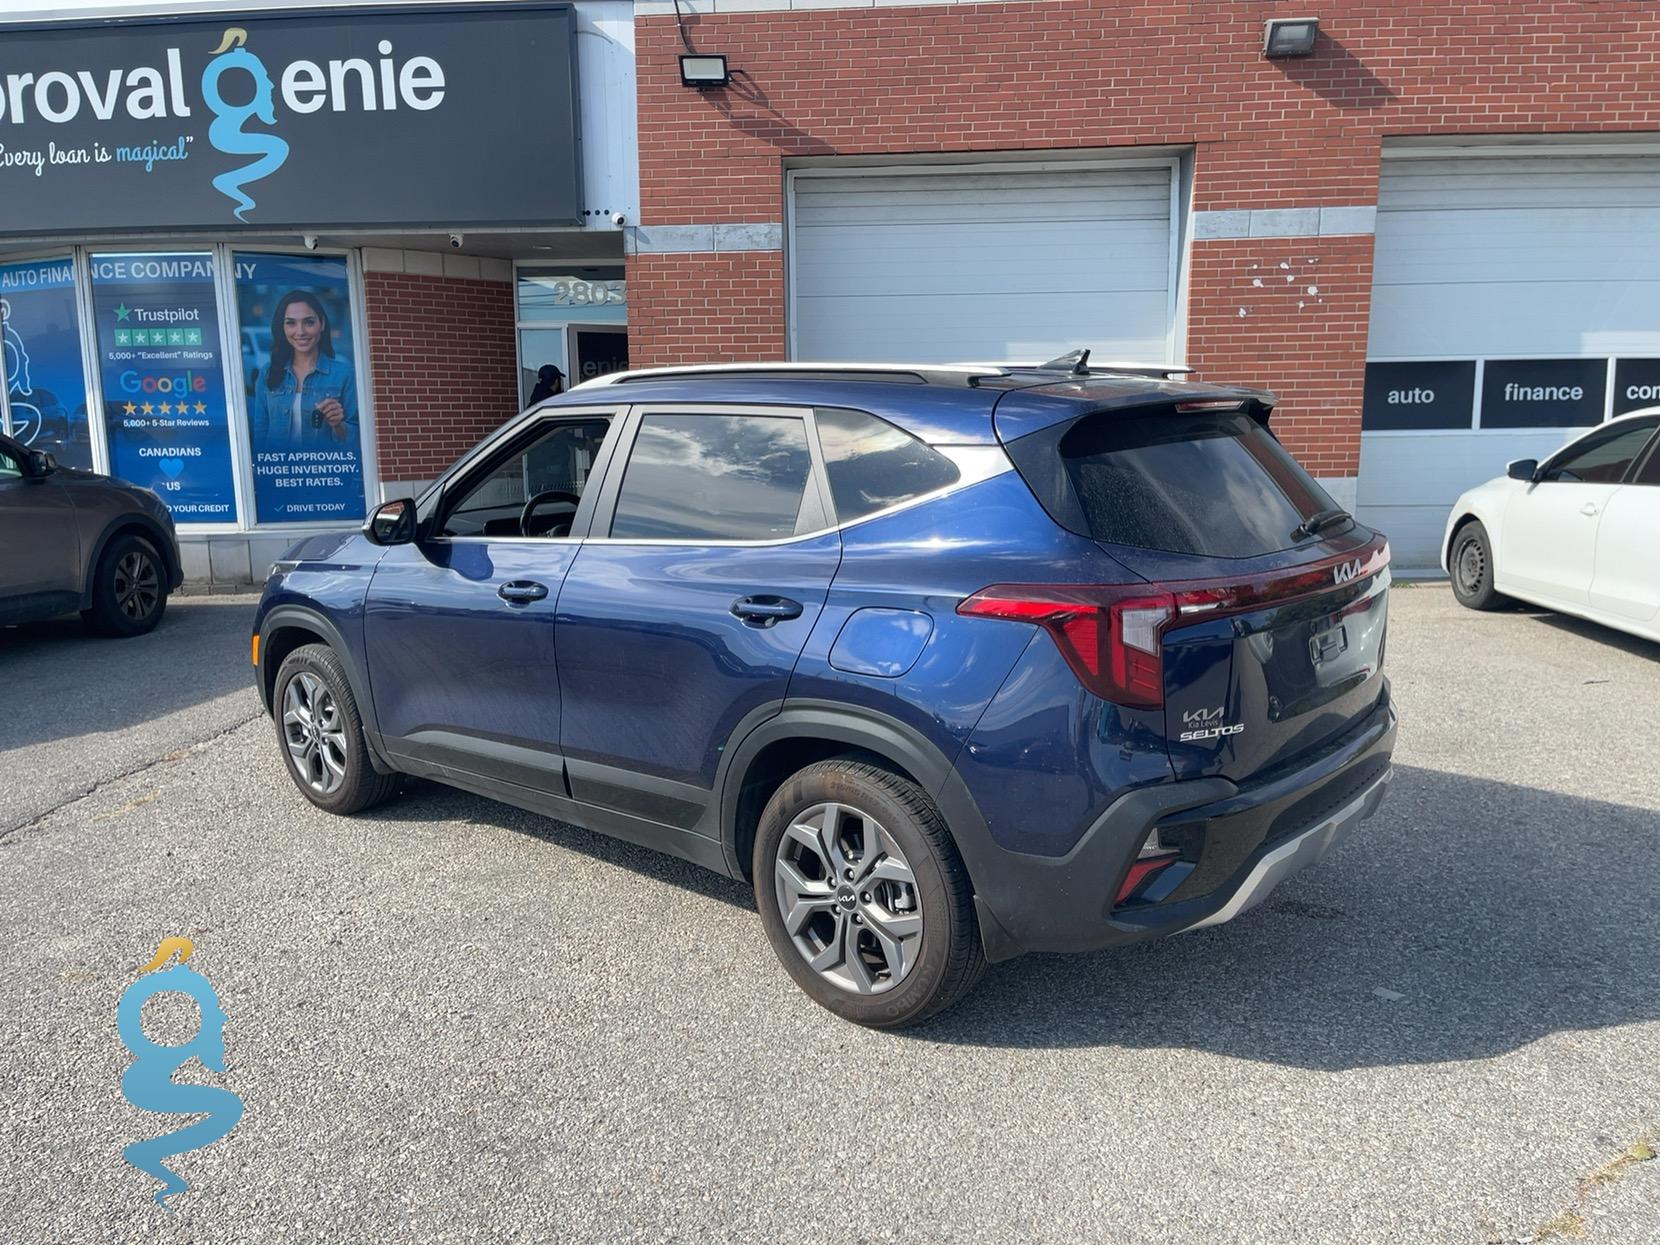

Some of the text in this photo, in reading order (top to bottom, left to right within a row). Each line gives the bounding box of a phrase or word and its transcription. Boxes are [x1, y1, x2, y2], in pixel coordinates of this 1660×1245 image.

[0, 48, 191, 123] roval
[48, 141, 91, 165] loan
[94, 142, 112, 163] is
[2, 270, 37, 288] AUTO
[553, 280, 627, 305] 2803
[134, 308, 200, 323] Trustpilot
[183, 351, 213, 360] Ratings
[120, 370, 206, 398] Google
[1387, 386, 1435, 404] auto
[1504, 382, 1584, 401] finance
[152, 419, 176, 427] 5-Star
[177, 419, 210, 427] Reviews
[139, 447, 202, 457] CANADIANS
[257, 451, 357, 463] FAST APPROVALS.
[256, 463, 359, 476] HUGE INVENTORY.
[166, 481, 181, 491] US
[275, 476, 344, 488] BEST RATES.
[173, 504, 197, 513] YOUR
[198, 504, 230, 513] CREDIT
[286, 502, 345, 513] DRIVE TODAY
[1179, 723, 1245, 742] SELTOS
